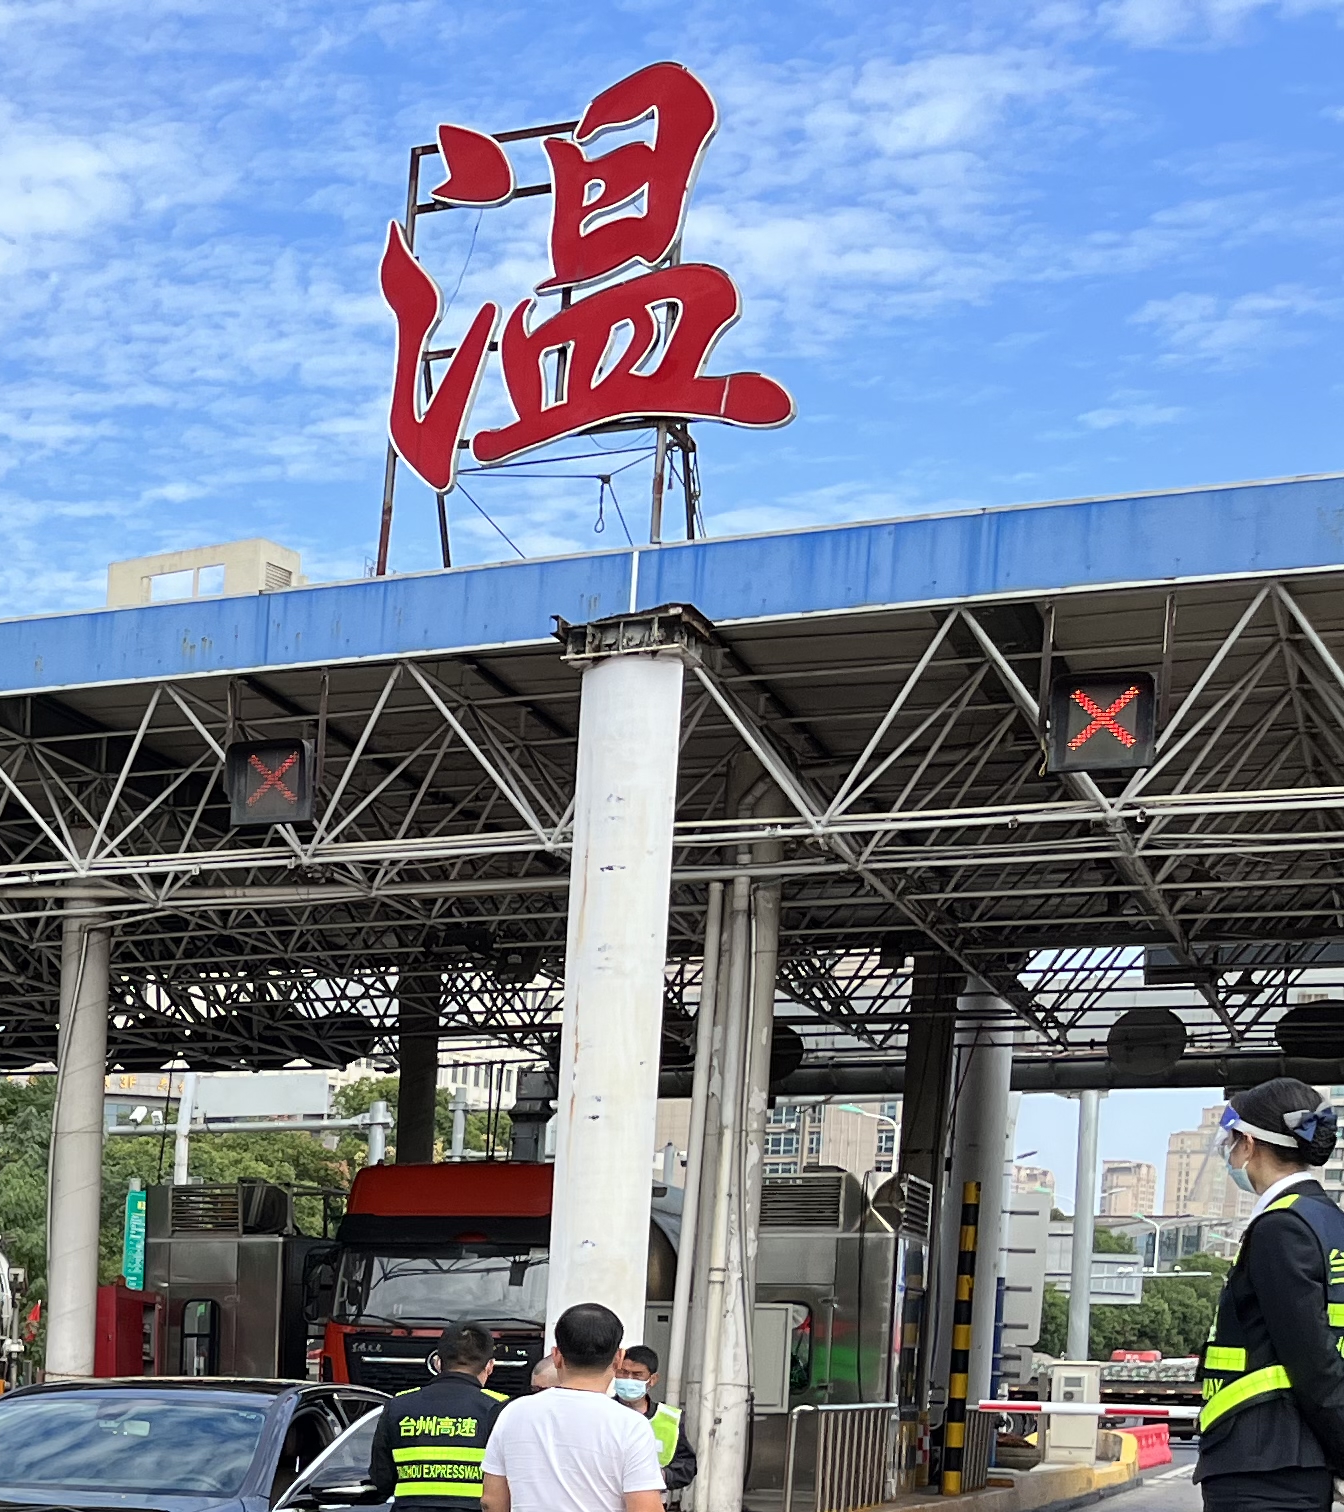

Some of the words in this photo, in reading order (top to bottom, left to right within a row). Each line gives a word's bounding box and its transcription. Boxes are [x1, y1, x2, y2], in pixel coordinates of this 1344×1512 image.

[379, 61, 798, 495] 温
[398, 1415, 478, 1437] 台州高速
